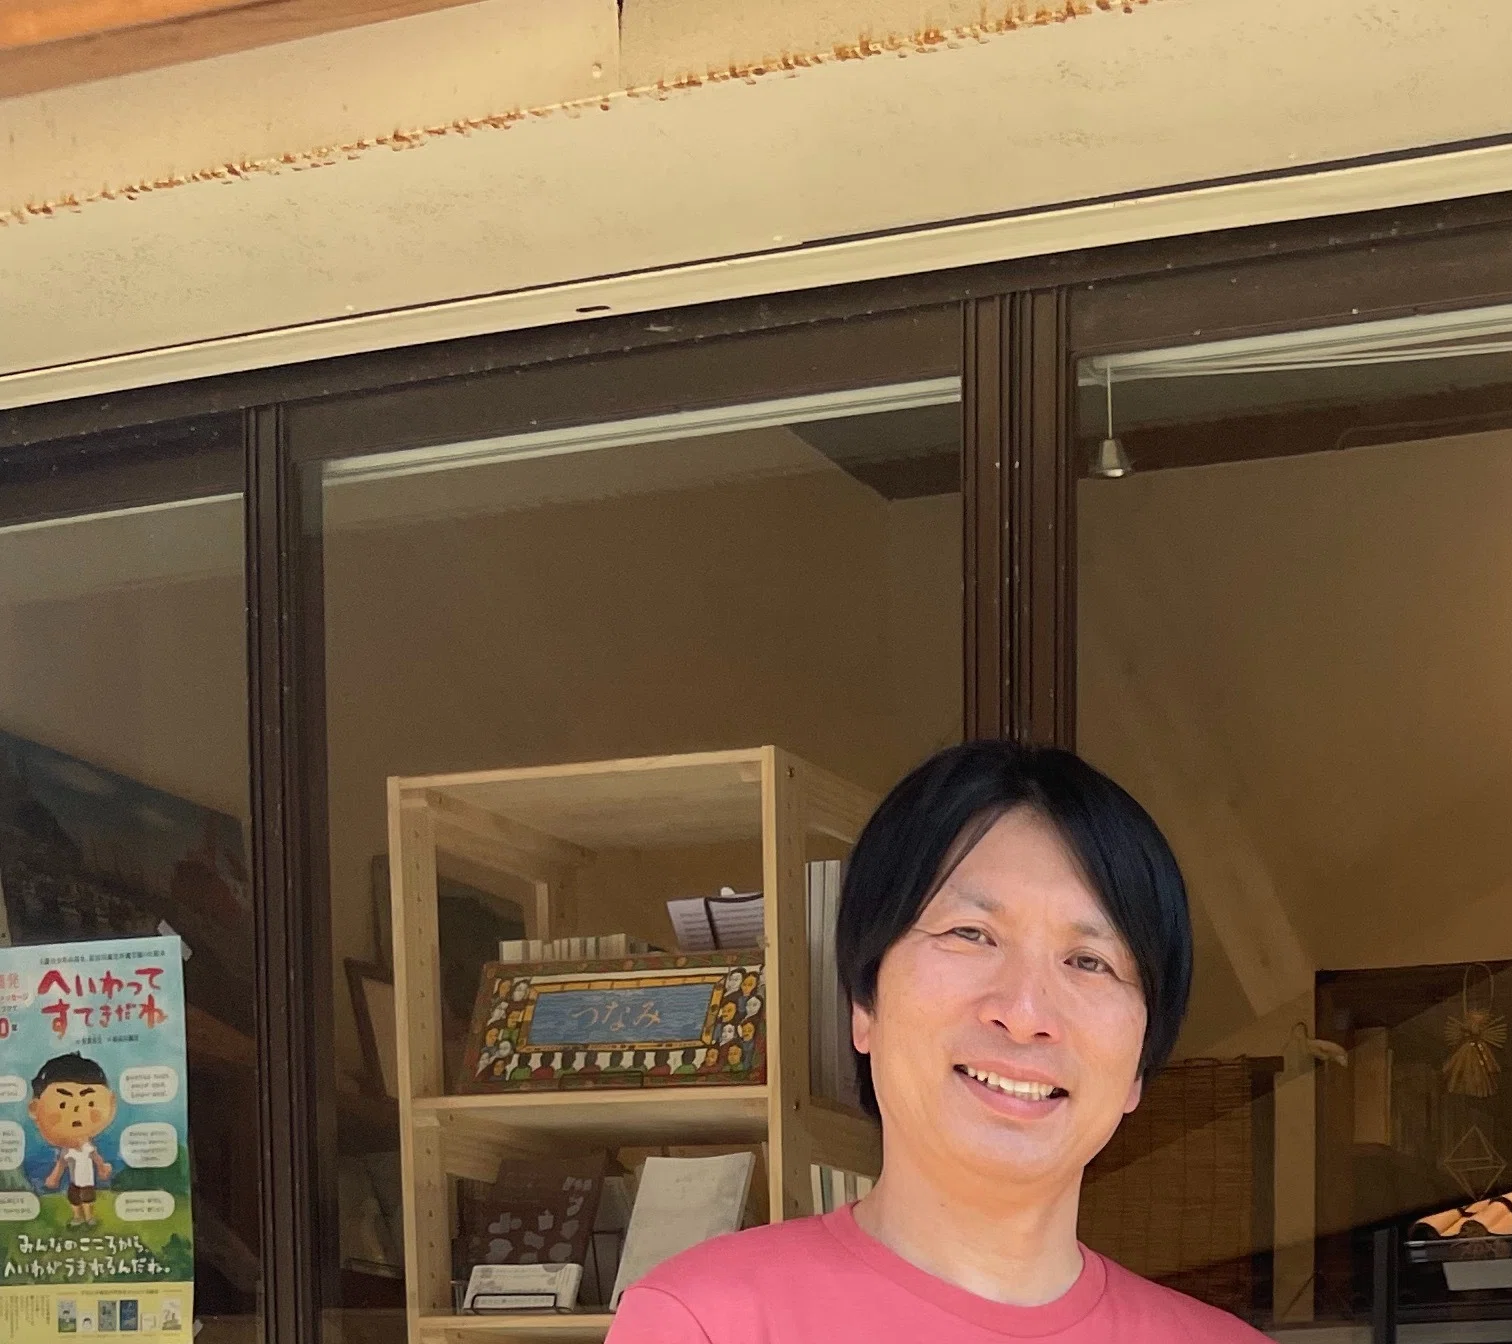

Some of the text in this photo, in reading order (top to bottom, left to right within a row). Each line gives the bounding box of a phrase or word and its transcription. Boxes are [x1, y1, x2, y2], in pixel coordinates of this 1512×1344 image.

[38, 967, 164, 999] へいわって
[41, 993, 168, 1039] すてきだね
[567, 1000, 661, 1032] つなみ
